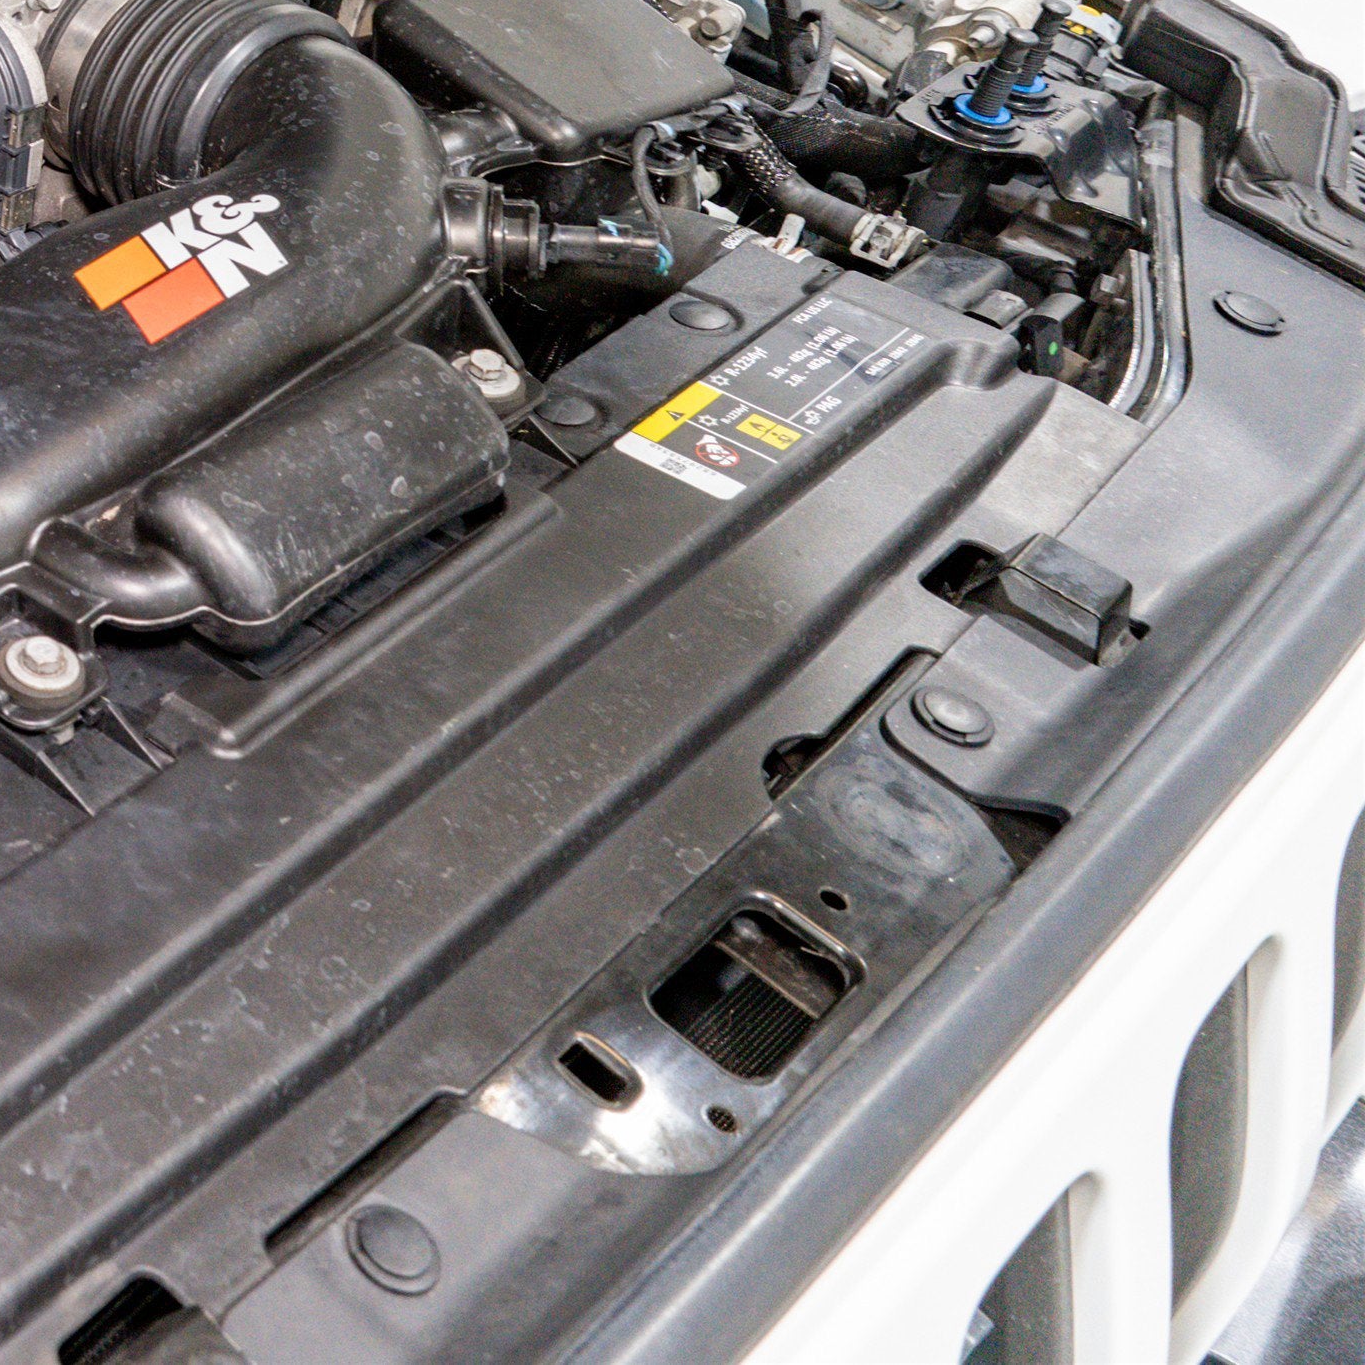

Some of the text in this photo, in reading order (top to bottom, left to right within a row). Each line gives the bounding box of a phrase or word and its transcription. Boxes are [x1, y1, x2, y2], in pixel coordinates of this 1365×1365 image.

[140, 194, 289, 299] K&N
[791, 311, 812, 324] FCA
[804, 304, 822, 315] US
[722, 345, 771, 377] R-1234yf
[813, 394, 843, 413] PAG
